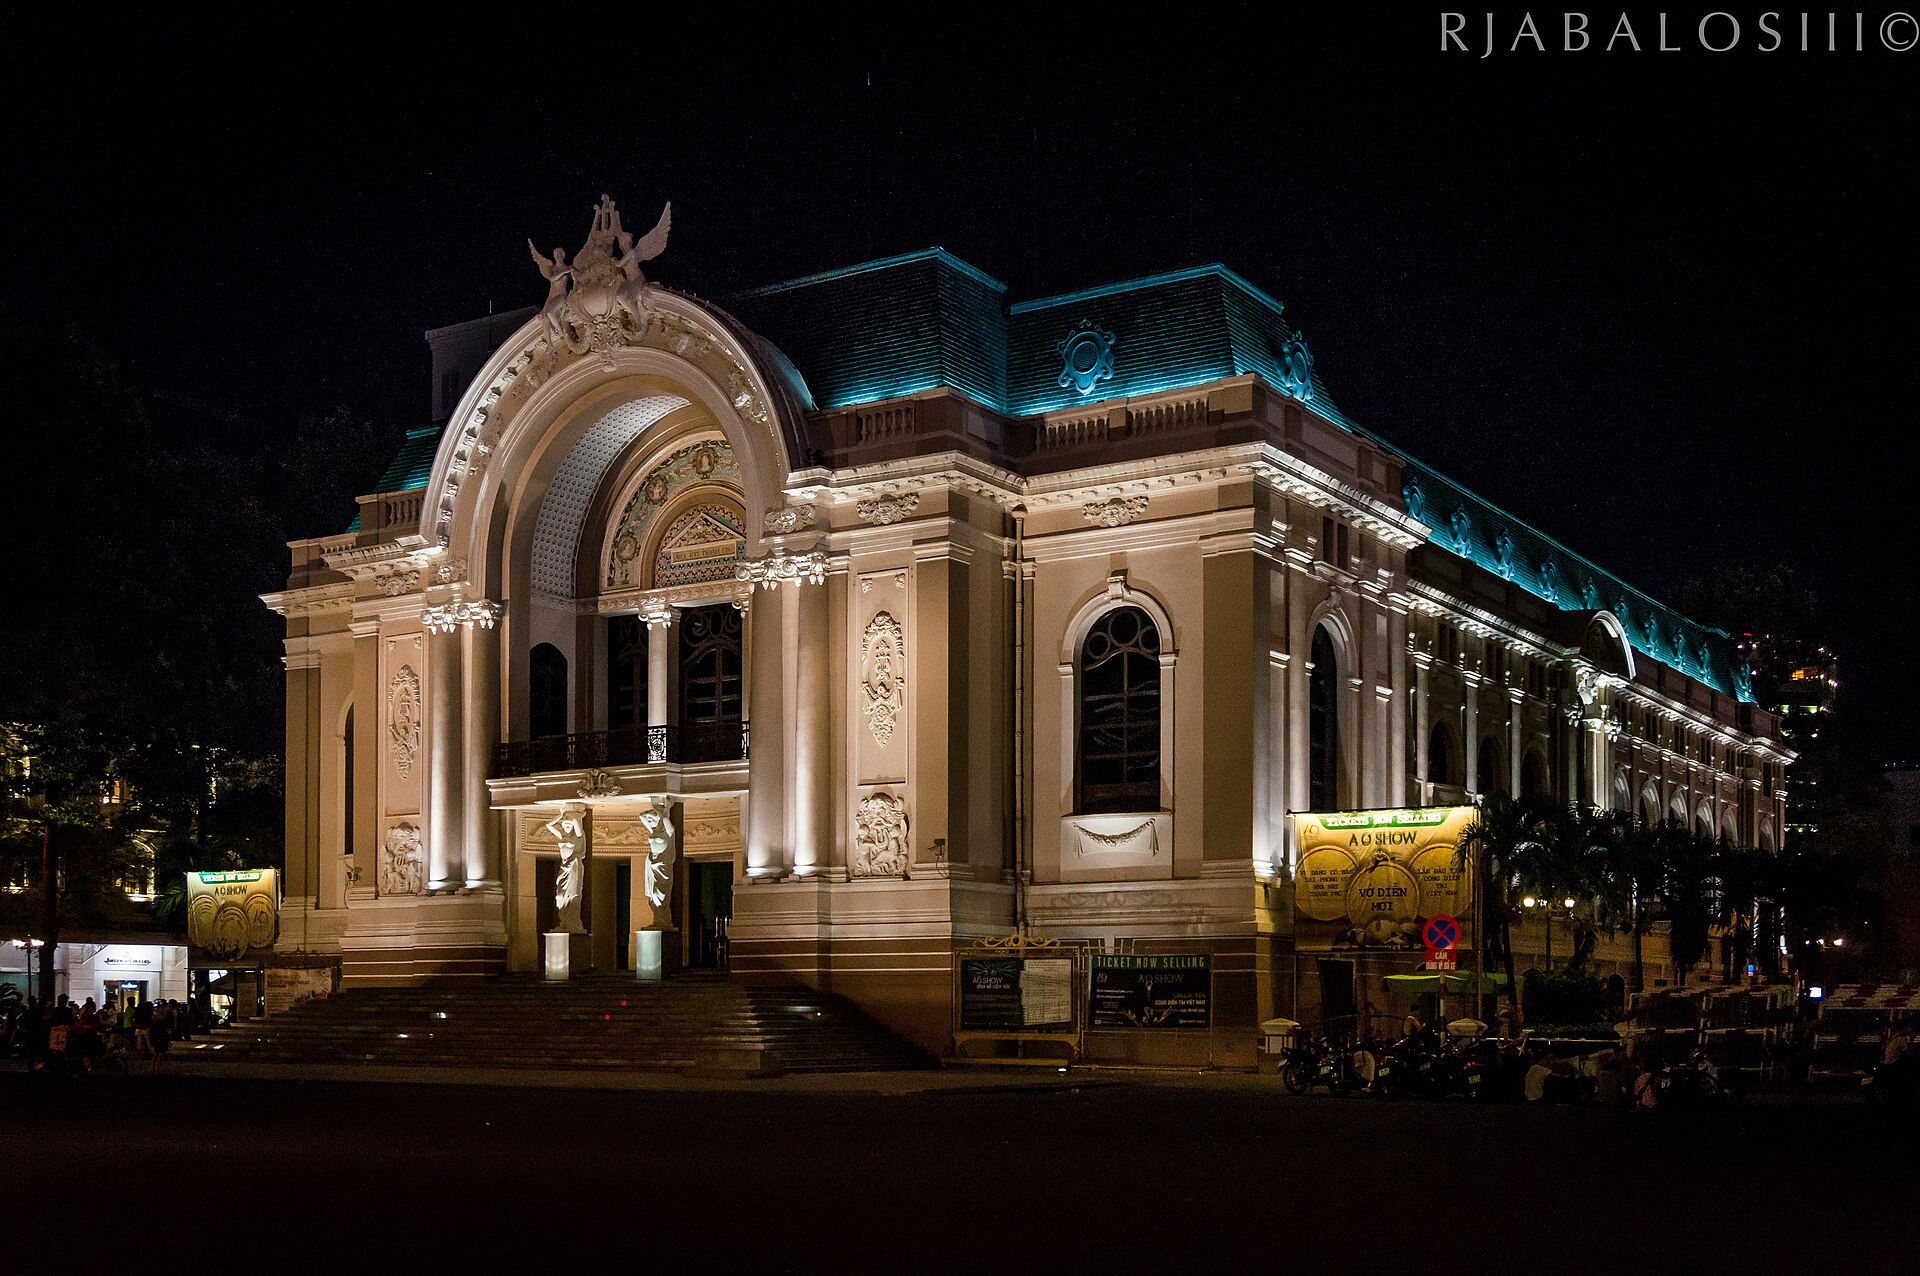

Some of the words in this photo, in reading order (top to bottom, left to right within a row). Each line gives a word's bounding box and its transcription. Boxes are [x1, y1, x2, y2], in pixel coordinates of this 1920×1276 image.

[1326, 817, 1369, 827] TICKETS
[1373, 816, 1393, 825] NOW
[1397, 813, 1441, 824] SELLING
[1375, 831, 1417, 846] SHOW
[1097, 956, 1130, 968] TICKET
[1136, 956, 1157, 968] NOW
[1163, 956, 1205, 968] SELLING
[1154, 974, 1184, 983] SHOW
